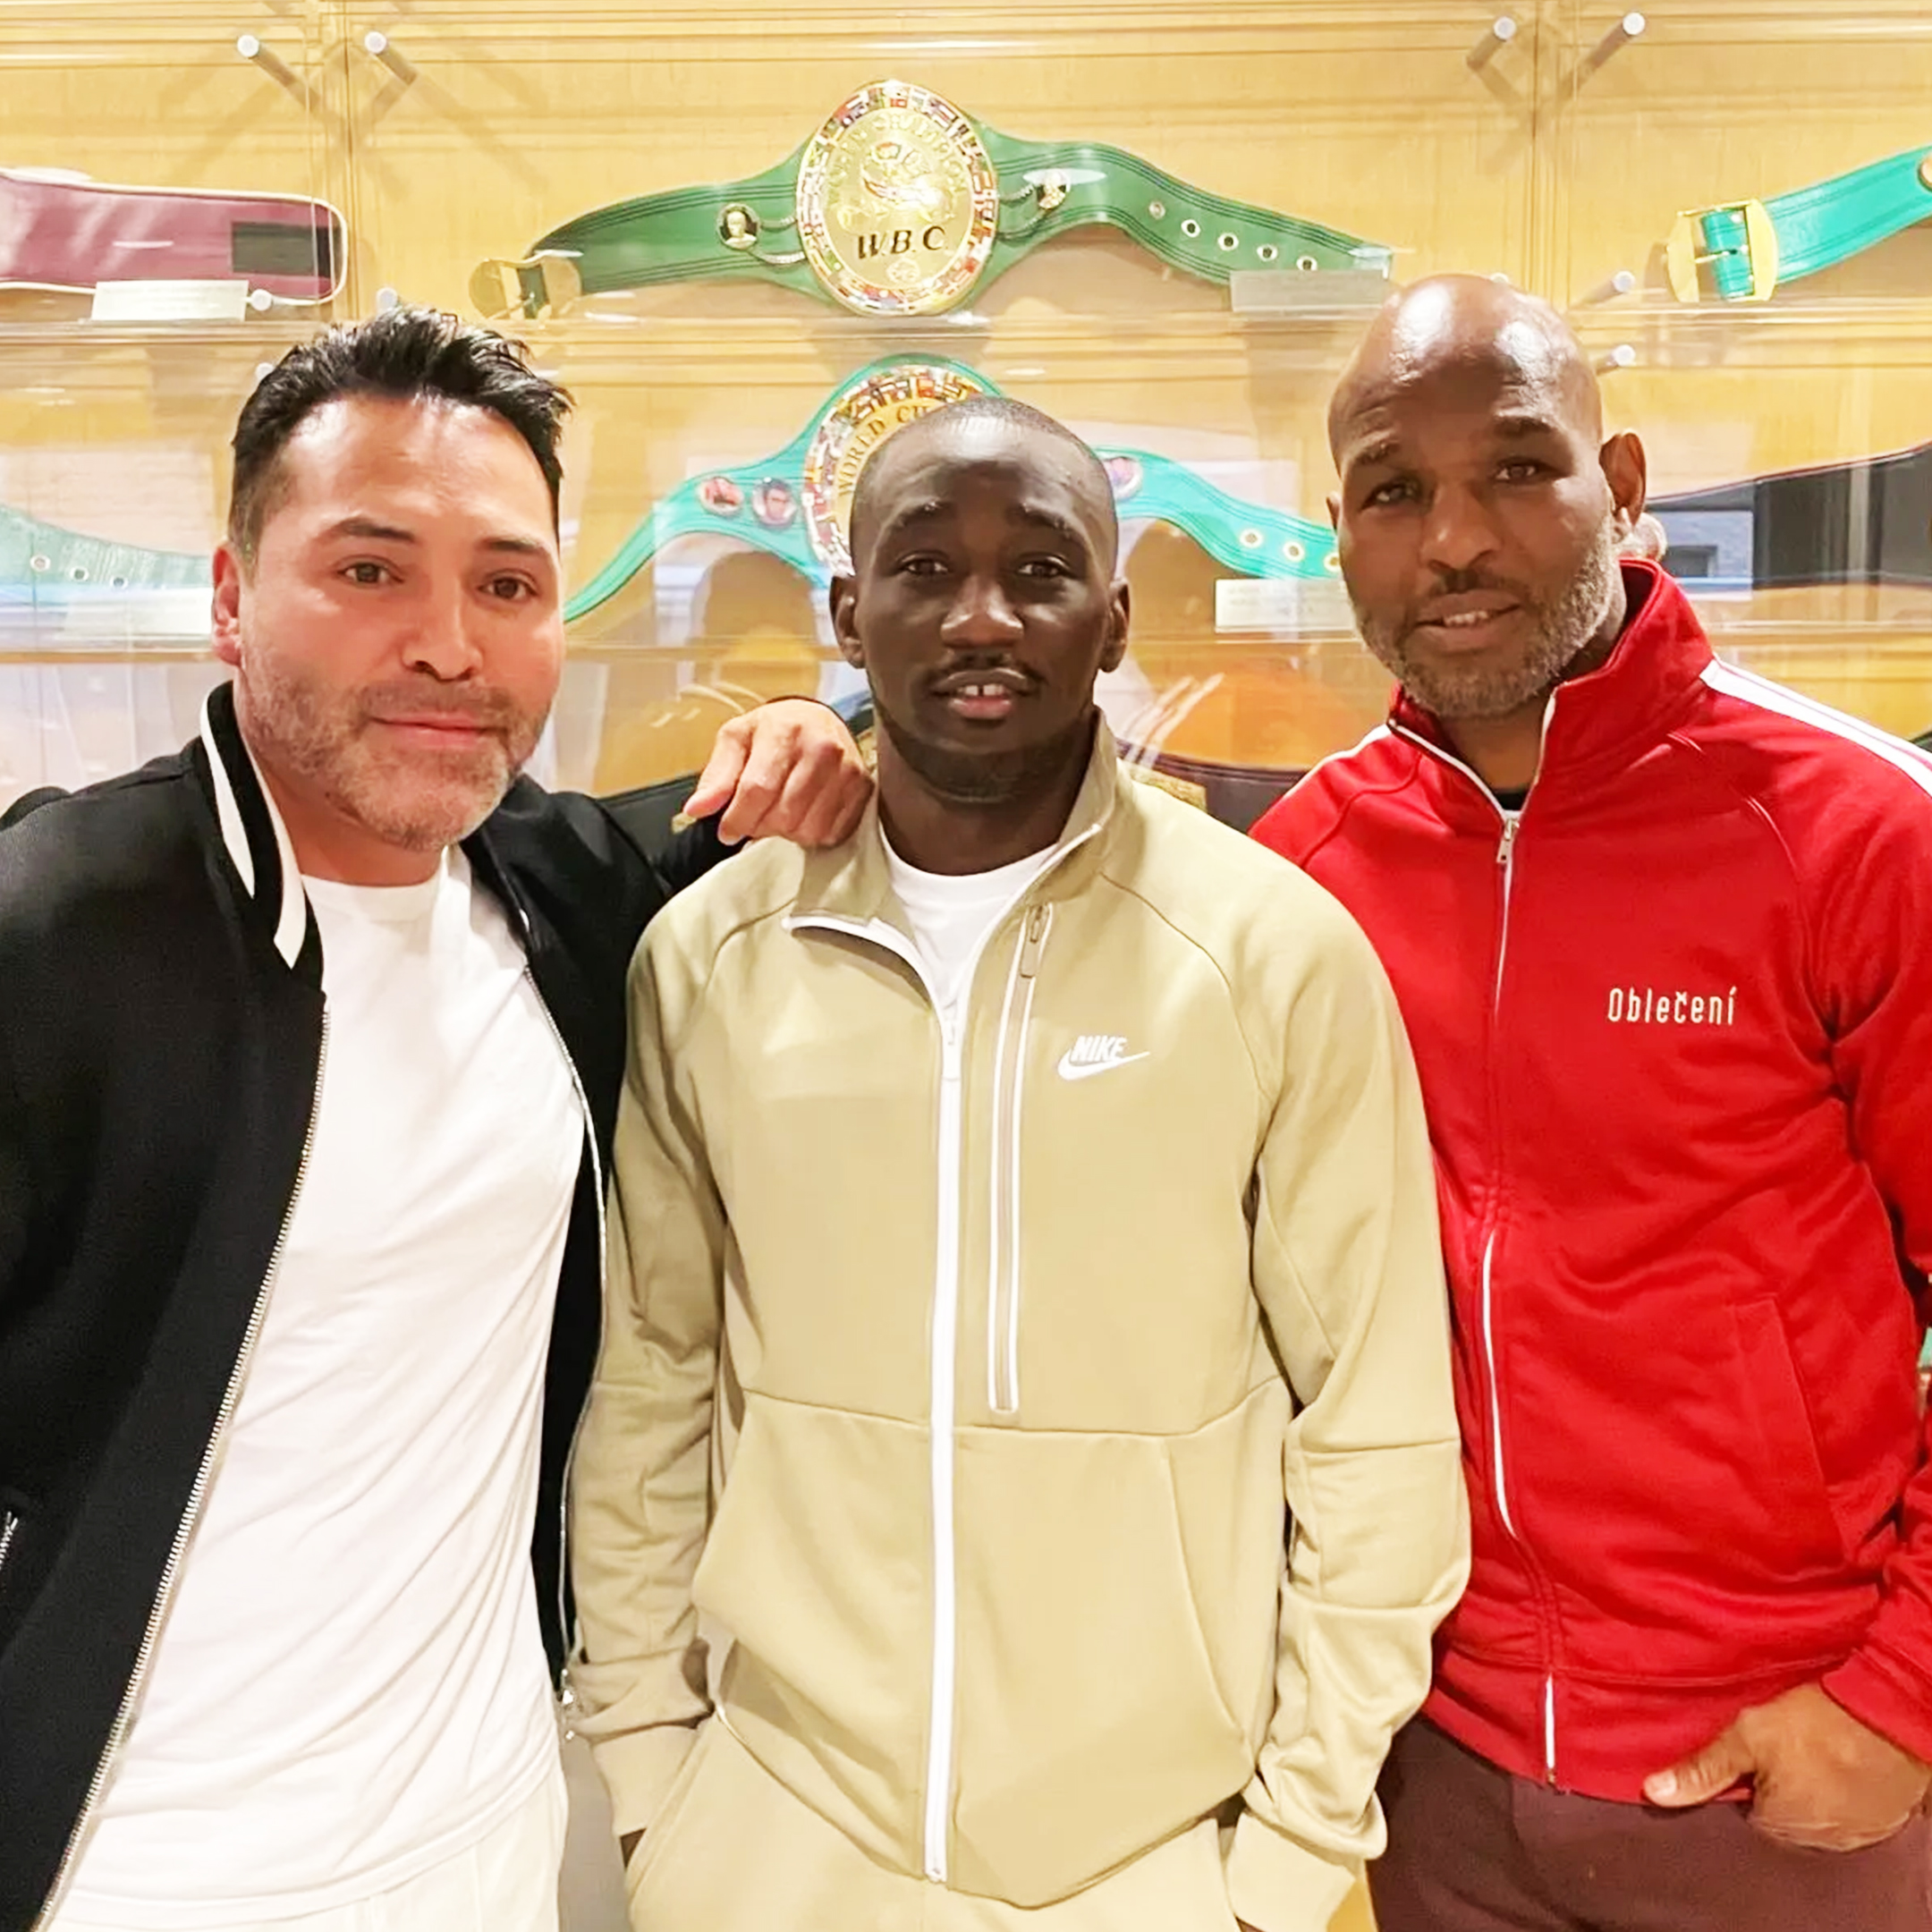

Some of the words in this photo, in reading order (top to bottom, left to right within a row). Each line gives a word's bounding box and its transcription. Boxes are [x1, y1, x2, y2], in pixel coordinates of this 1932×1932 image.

[837, 419, 886, 497] WORLD
[1607, 986, 1737, 1026] Oblečení
[1070, 1035, 1129, 1063] NIKE
